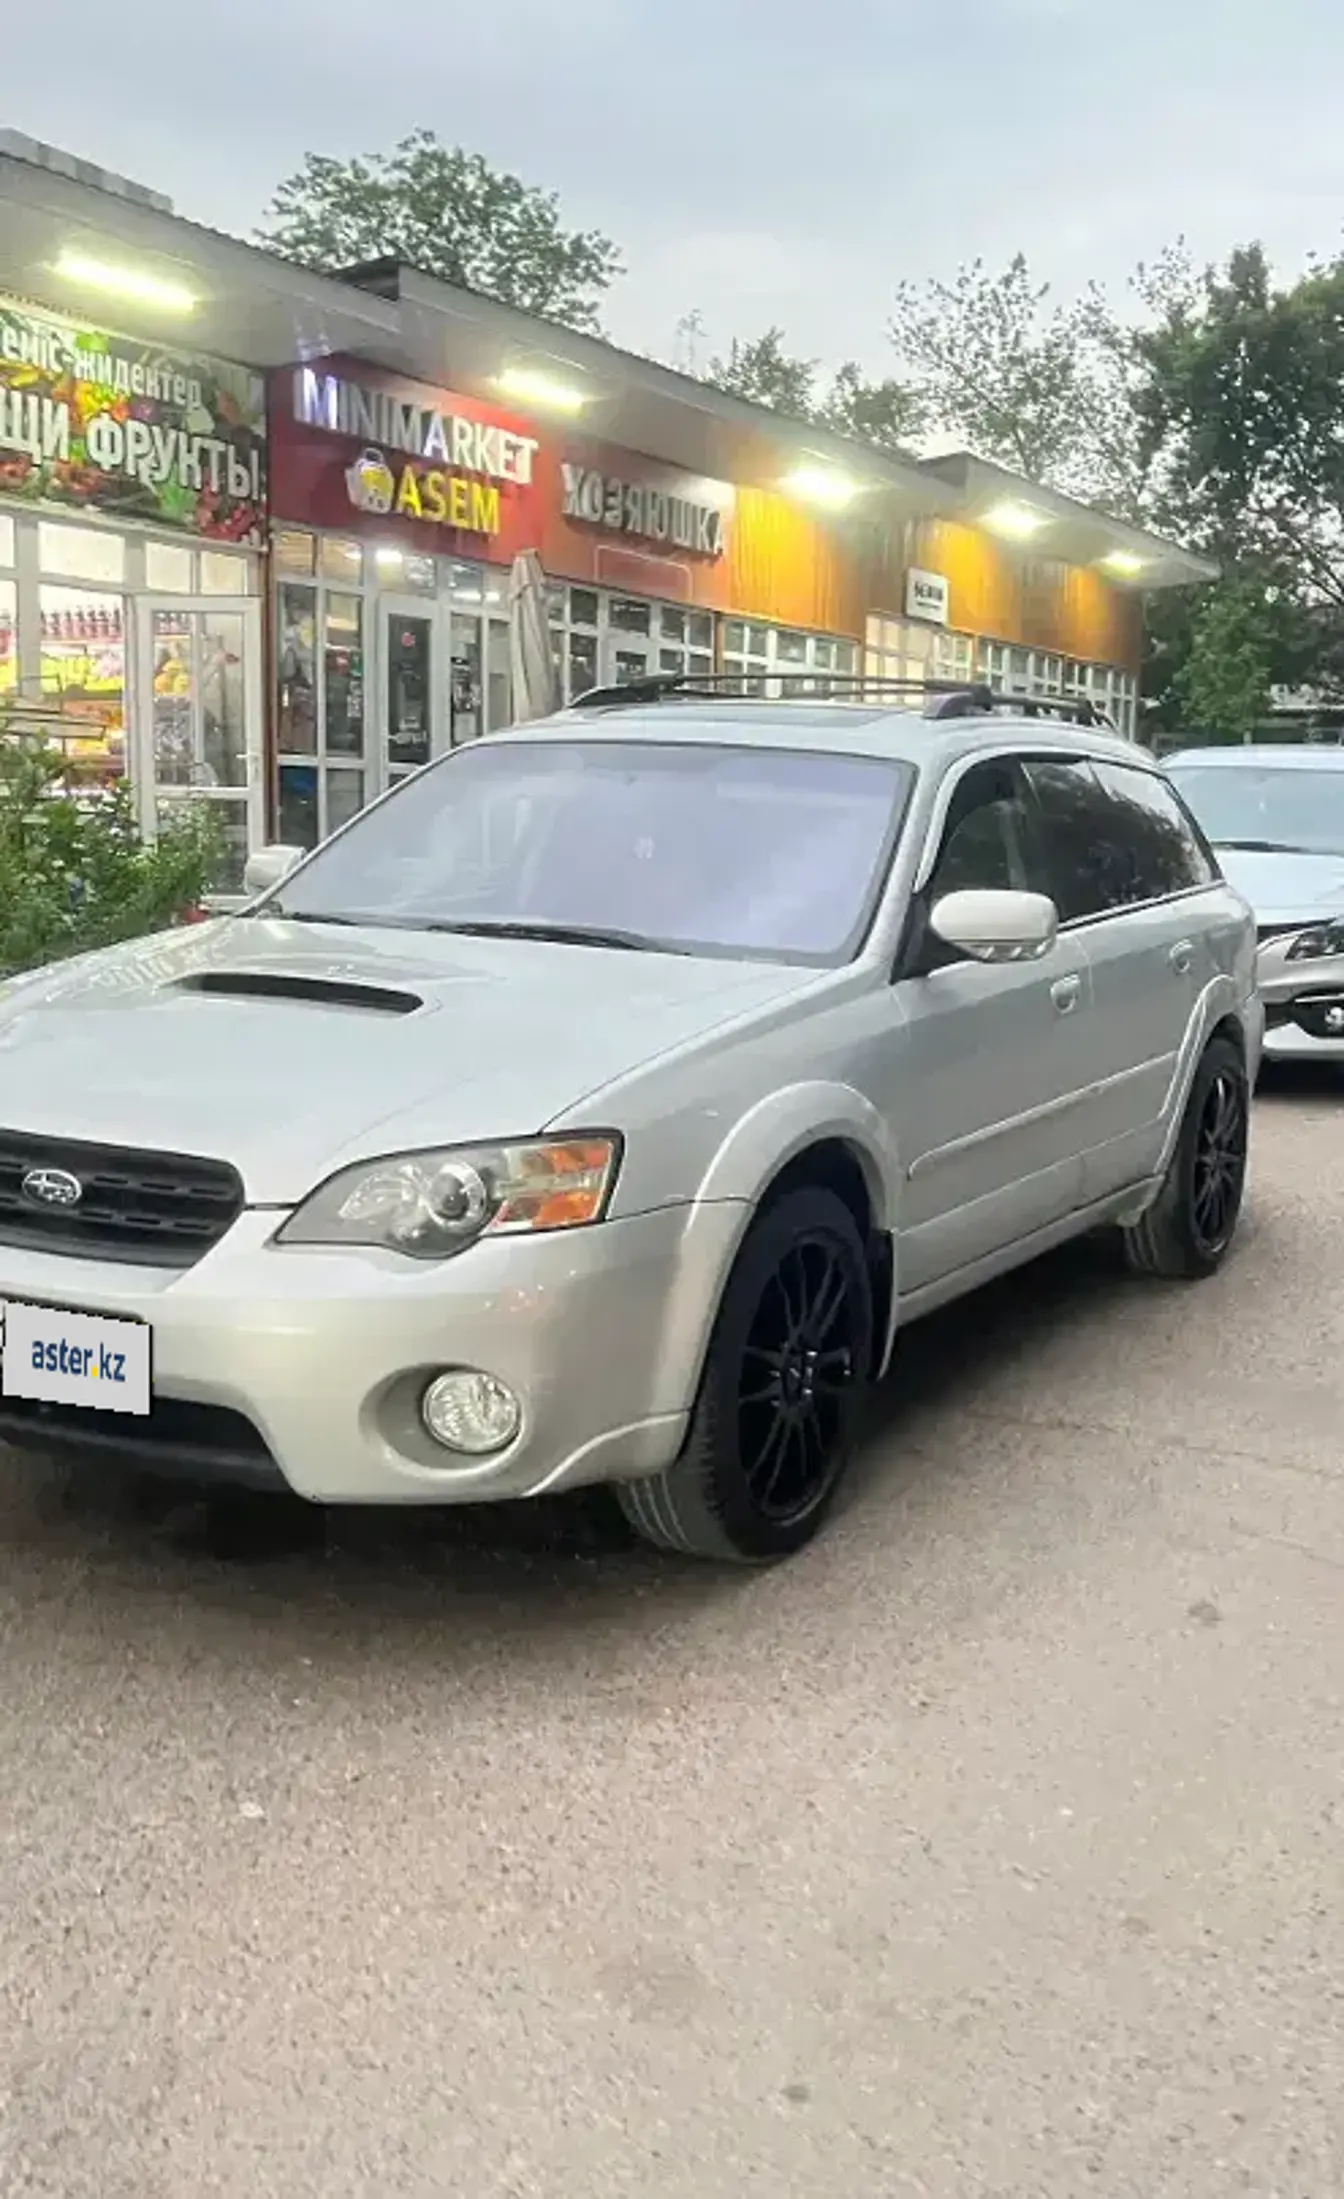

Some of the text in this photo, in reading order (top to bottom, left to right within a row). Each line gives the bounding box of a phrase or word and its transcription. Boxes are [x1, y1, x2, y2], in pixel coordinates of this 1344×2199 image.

[87, 411, 258, 500] ФРУКТЫ
[293, 367, 538, 484] MINIMARKET
[397, 465, 499, 536] ASEM
[561, 463, 723, 555] ХОЗЯЮШКА
